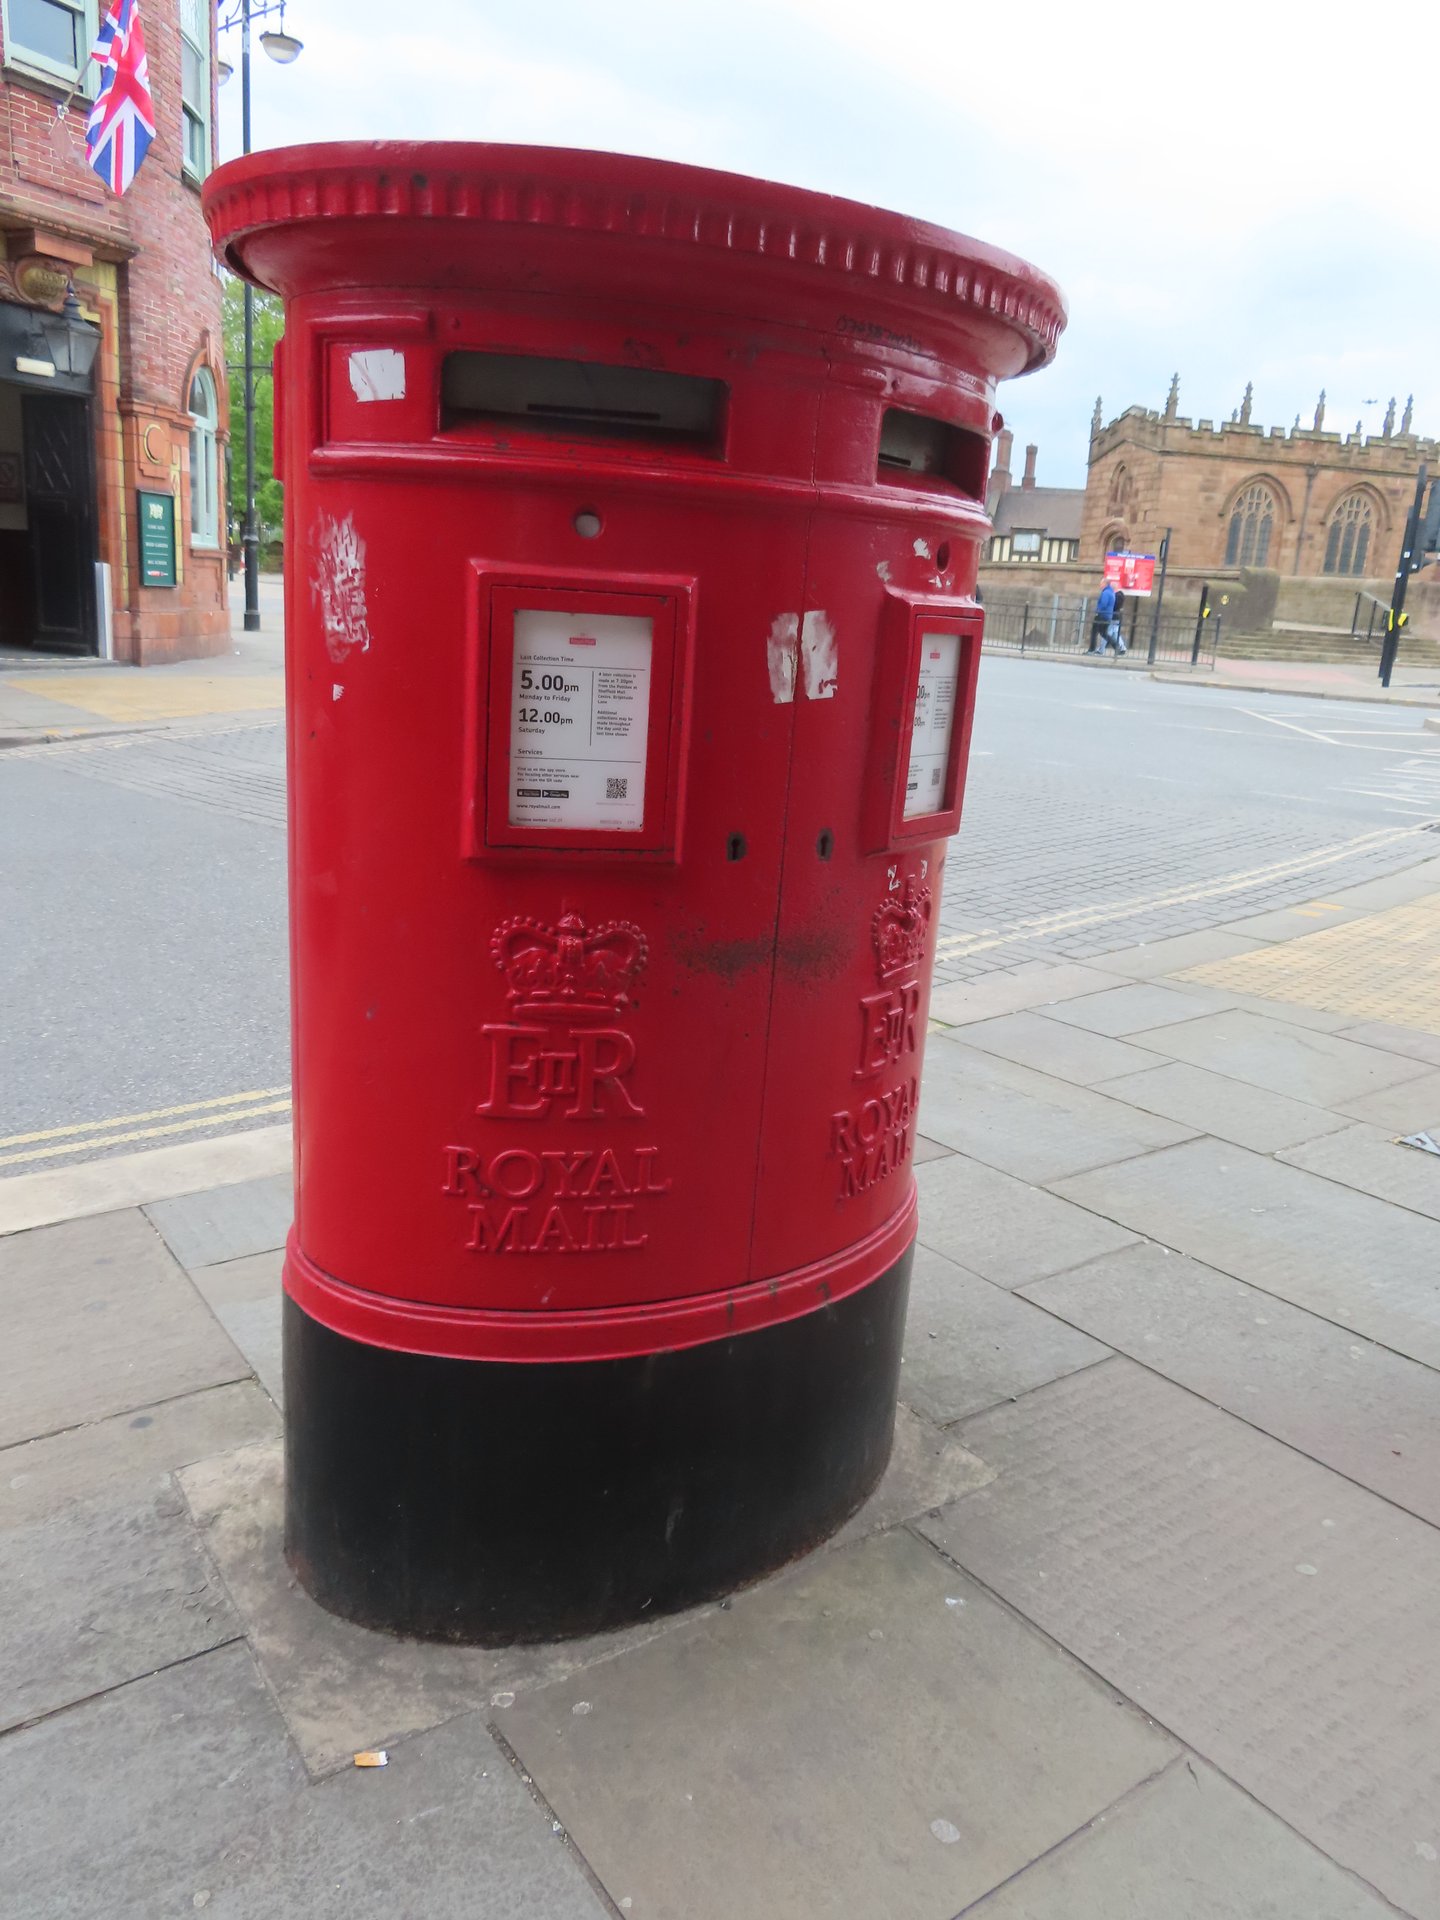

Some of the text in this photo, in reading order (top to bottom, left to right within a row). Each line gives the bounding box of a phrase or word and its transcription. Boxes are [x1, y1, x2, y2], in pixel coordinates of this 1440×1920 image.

[519, 693, 543, 701] Monday
[520, 670, 579, 693] 5.00pm
[519, 708, 573, 725] 12.00pm
[829, 1077, 920, 1157] ROYAL
[441, 1145, 673, 1198] ROYAL
[838, 1125, 912, 1200] MAIL
[464, 1204, 649, 1254] MAIL
